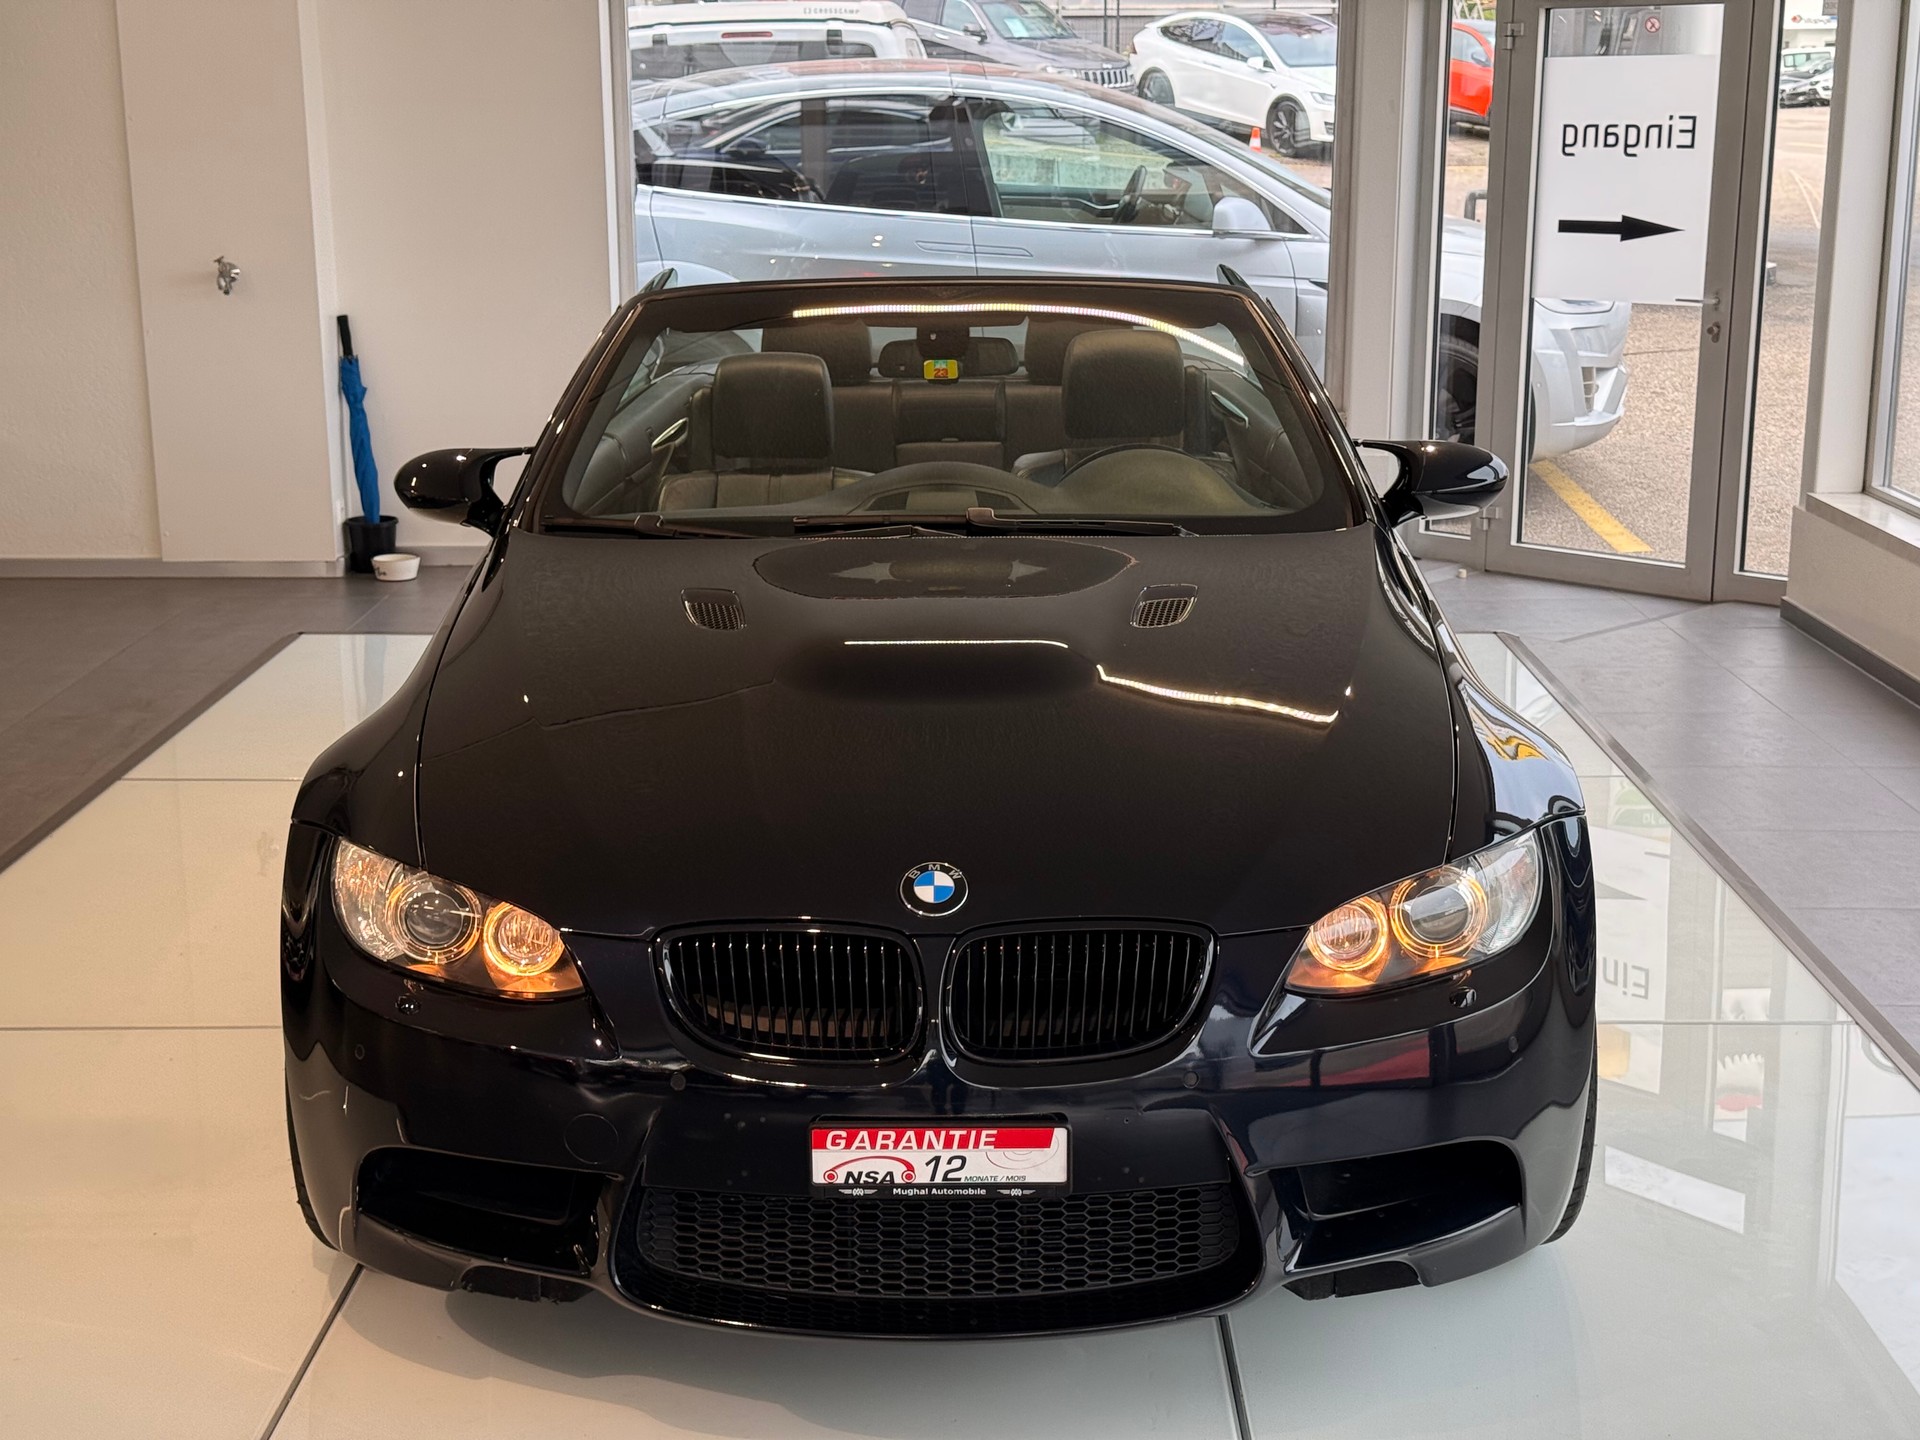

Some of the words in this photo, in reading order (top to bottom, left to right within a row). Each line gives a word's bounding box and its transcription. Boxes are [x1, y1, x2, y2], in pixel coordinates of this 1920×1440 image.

[908, 864, 962, 880] BMW
[825, 1130, 998, 1150] GARANTIE
[925, 1155, 967, 1182] 12
[844, 1170, 896, 1184] NSA
[893, 1187, 928, 1196] Mughal
[931, 1187, 987, 1196] Automobile
